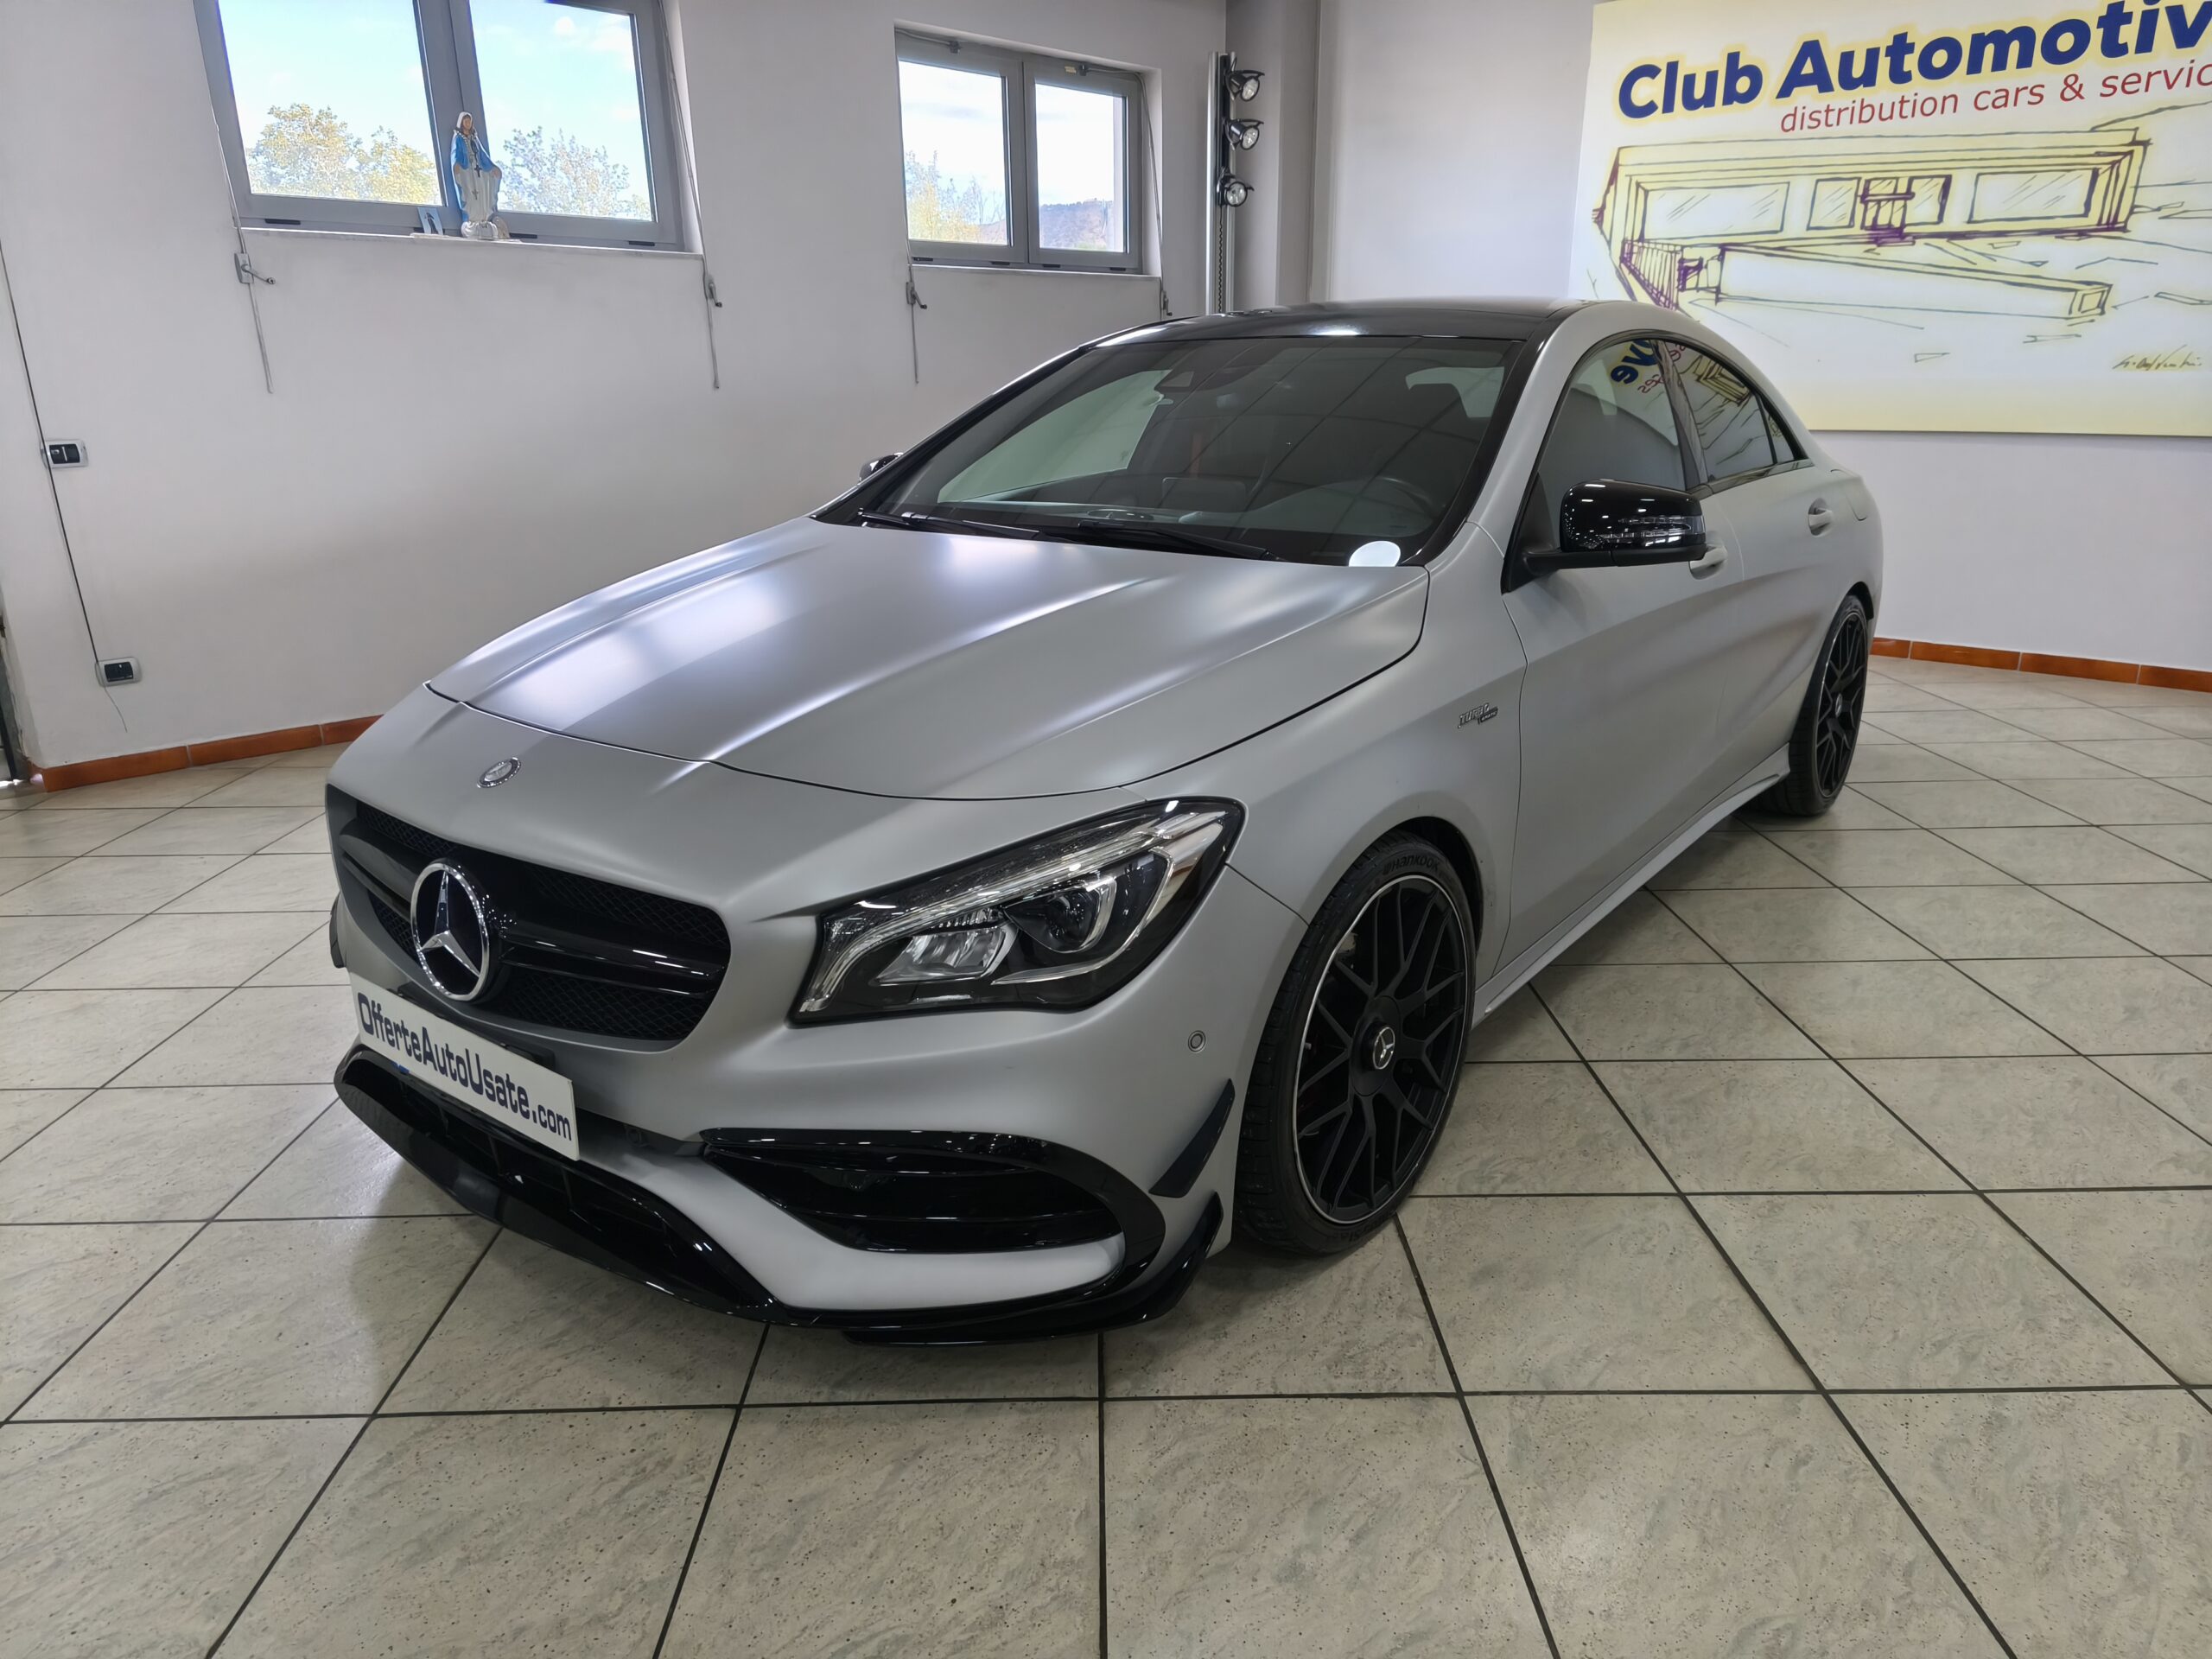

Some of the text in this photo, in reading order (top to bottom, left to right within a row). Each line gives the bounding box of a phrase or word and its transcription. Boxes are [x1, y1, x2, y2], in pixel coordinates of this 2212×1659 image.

[1618, 0, 2212, 118] Club Automotiv
[1781, 60, 2212, 133] distribution cars & servic
[358, 992, 572, 1141] OfferteAutoUsate.com
